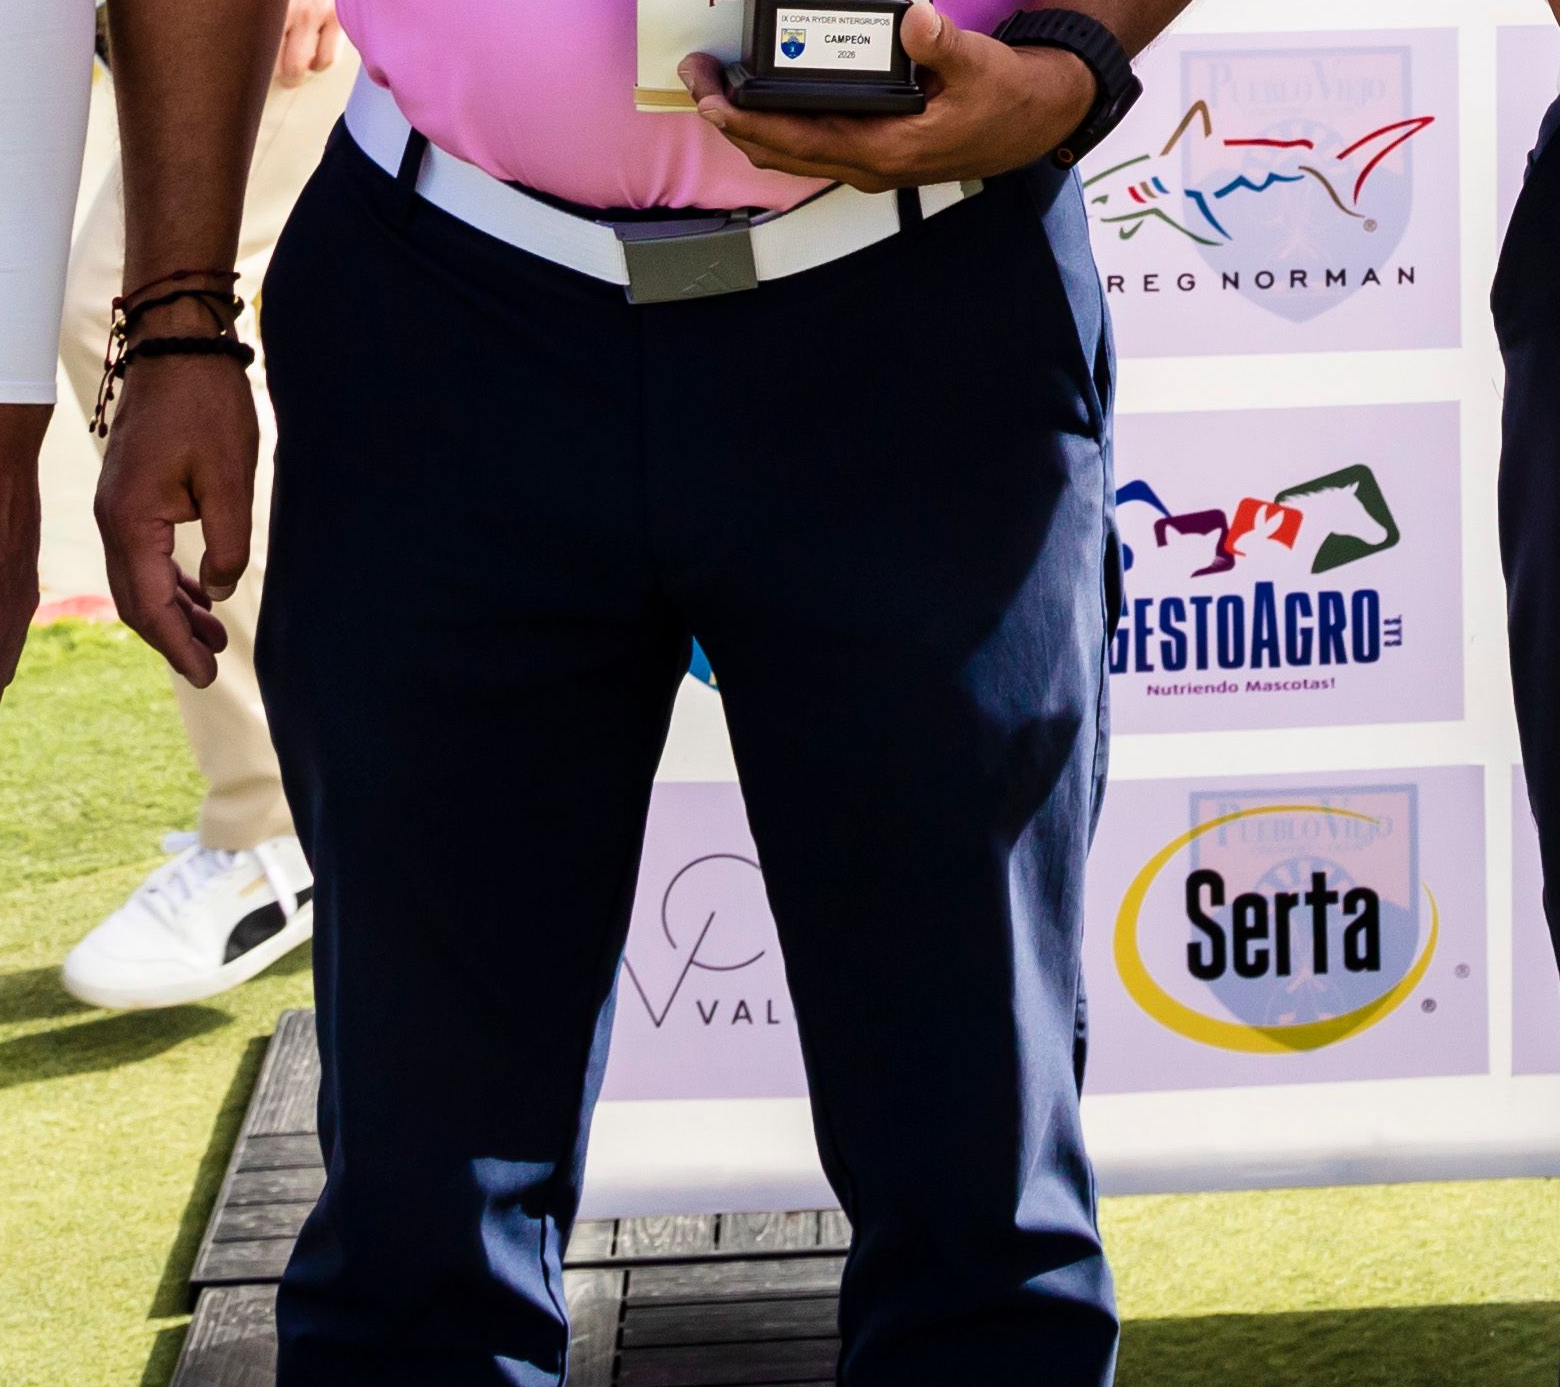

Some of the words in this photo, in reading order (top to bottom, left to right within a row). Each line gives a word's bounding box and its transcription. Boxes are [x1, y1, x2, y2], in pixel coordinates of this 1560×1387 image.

[790, 15, 810, 23] COPA
[839, 17, 890, 26] INTERGRUPOS
[824, 33, 871, 45] CAMPEÓN
[837, 50, 856, 59] 2026
[1107, 273, 1196, 292] REG
[1222, 267, 1414, 289] NORMAN
[1147, 681, 1239, 697] Nutriendo
[1245, 677, 1336, 692] Mascotas!
[1186, 869, 1380, 981] Serta
